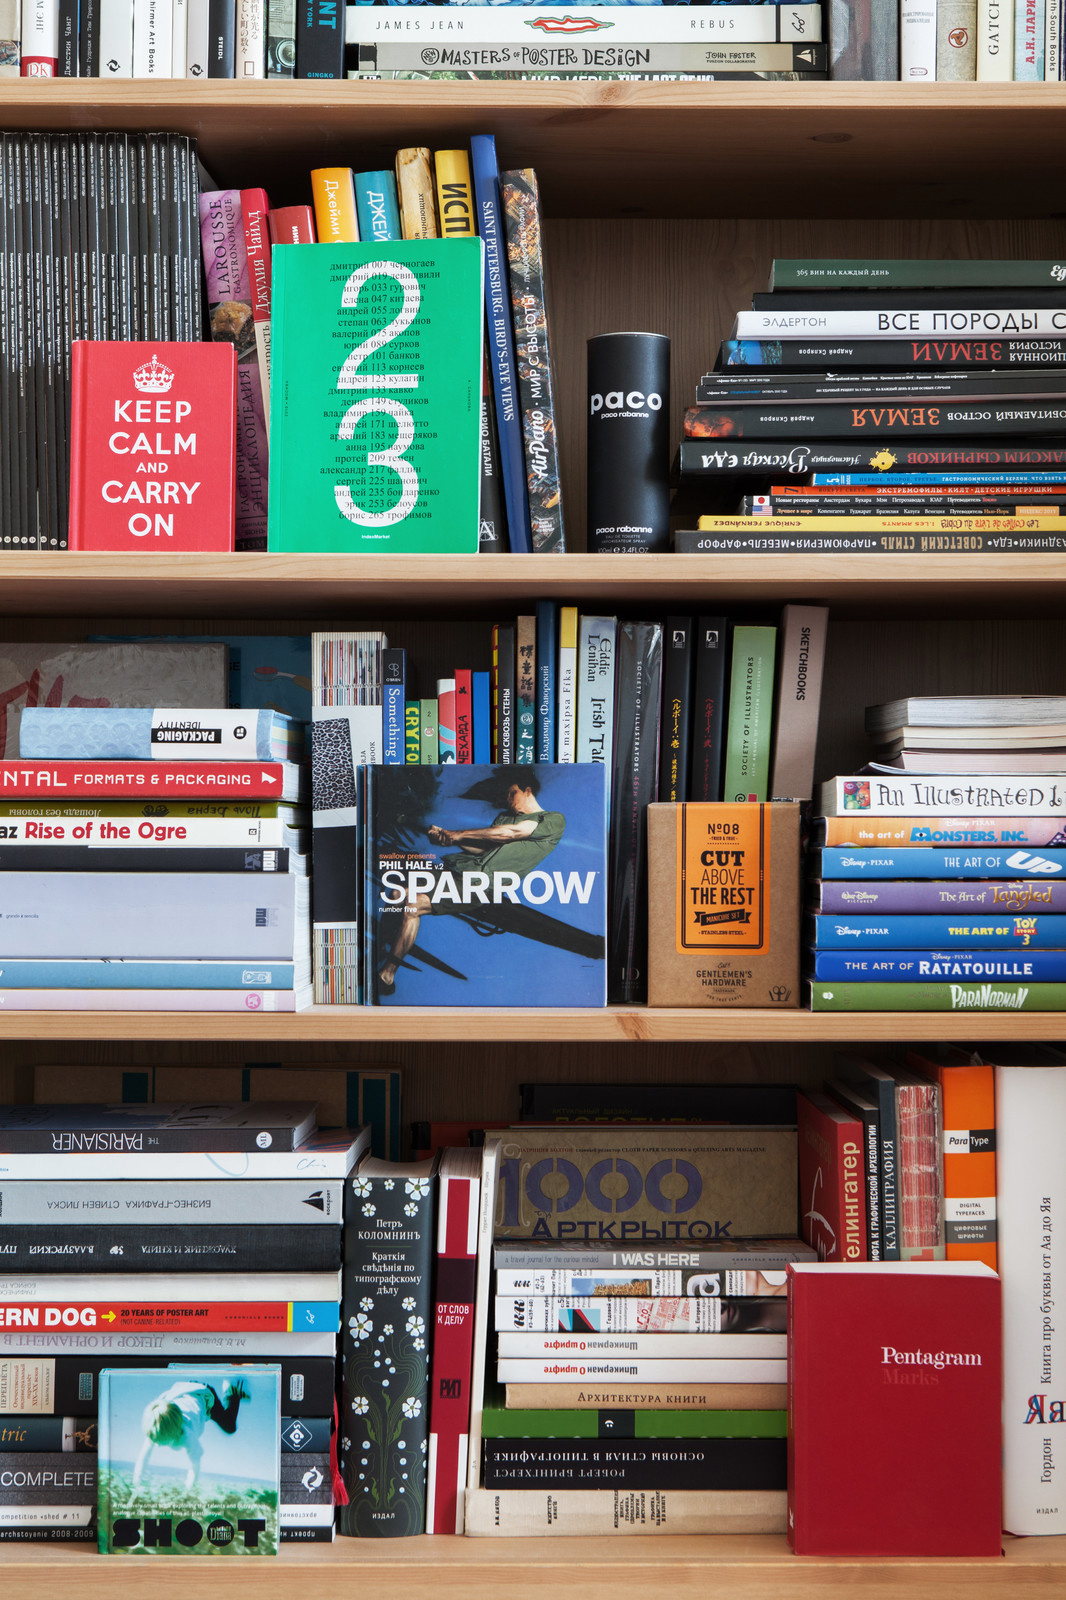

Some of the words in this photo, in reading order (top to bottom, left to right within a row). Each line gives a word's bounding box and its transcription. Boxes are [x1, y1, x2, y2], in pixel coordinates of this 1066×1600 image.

[376, 21, 420, 30] JAMES
[430, 21, 464, 30] JEAN
[690, 20, 735, 29] REBUS
[441, 47, 510, 66] MASTERS
[521, 47, 578, 66] POSTER
[705, 51, 727, 59] JOHN
[323, 180, 341, 235] Джейми
[247, 210, 262, 256] Чайлд
[209, 199, 232, 295] LAROUSSE
[224, 198, 242, 294] GASTRONOMIQUE
[330, 261, 369, 271] дмитрий
[371, 260, 387, 268] 007
[838, 268, 869, 276] КАЖДЫЙ
[255, 259, 272, 314] Джулия
[336, 306, 368, 315] андрей
[371, 306, 387, 314] 055
[483, 201, 496, 235] SAINT
[501, 387, 514, 422] VIEWS
[524, 295, 539, 353] ВЫСОТЫ
[763, 317, 827, 328] ЭЛДЕРТОН
[878, 313, 920, 331] ВСЕ
[933, 312, 1038, 332] ПОРОДЫ
[911, 342, 1002, 361] ЗЕМЛИ
[1009, 341, 1061, 350] ИСТОРИЯ
[528, 369, 542, 398] МИР
[590, 391, 662, 415] paco
[114, 399, 192, 423] KEEP
[600, 412, 618, 420] paco
[851, 408, 940, 427] ЗЕМЛЯ
[947, 411, 992, 420] ОСТРОВ
[108, 431, 196, 455] CALM
[907, 451, 1000, 464] СЫРНИКОВ
[136, 462, 168, 474] AND
[320, 466, 366, 475] александр
[369, 465, 385, 473] 217
[101, 480, 201, 504] CARRY
[128, 512, 174, 536] ON
[595, 527, 615, 535] paco
[616, 525, 653, 534] rabanne
[880, 536, 915, 550] СТИЛЬ
[921, 535, 983, 552] СОВЕТСКИЙ
[587, 634, 600, 682] Lenihan
[599, 637, 612, 676] Eddie
[796, 626, 811, 701] SKETCHBOOKS
[562, 669, 572, 694] Fika
[744, 656, 754, 722] ILLUSTRATORS
[502, 688, 511, 716] СТЕНЫ
[590, 696, 606, 728] Irish
[158, 721, 202, 730] IDENTITY
[385, 688, 400, 757] Something
[405, 707, 420, 740] CRY
[562, 698, 573, 746] maxipsa
[156, 731, 216, 742] PACKAGING
[502, 717, 511, 748] СКВОЗЬ
[744, 724, 750, 736] OF
[539, 717, 551, 761] Владимир
[633, 713, 641, 772] ILLUSTRATORS
[73, 773, 146, 786] FORMATS
[150, 773, 160, 786] &
[165, 773, 252, 786] PACKAGING
[25, 821, 65, 840] Rise
[72, 821, 94, 840] of
[100, 821, 131, 840] the
[138, 821, 188, 842] Ogre
[1001, 831, 1028, 842] INC.
[407, 853, 436, 861] presents
[700, 850, 746, 866] CUT
[870, 858, 894, 866] PIXAR
[944, 857, 961, 868] THE
[964, 857, 982, 868] ART
[985, 857, 1000, 868] OF
[379, 861, 404, 870] PHIL
[405, 861, 432, 870] HALE
[701, 868, 744, 886] ABOVE
[380, 870, 596, 905] SPARROW
[690, 887, 718, 905] THE
[721, 887, 756, 906] REST
[989, 885, 1053, 911] Tangled
[1013, 917, 1038, 928] TOY
[845, 962, 868, 970] THE
[873, 962, 896, 970] ART
[899, 962, 914, 970] OF
[919, 961, 1033, 975] RATATOUILLE
[696, 970, 752, 979] GENTLEMEN'S
[702, 978, 746, 987] HARDWARE
[51, 1132, 144, 1150] PARISIANER
[868, 1124, 878, 1174] АРХЕОЛОГИИ
[883, 1140, 897, 1250] КАЛЛИГРАФИЯ
[47, 1201, 80, 1209] ЛИСКА
[82, 1200, 120, 1209] СТИВЕН
[126, 1200, 212, 1209] БИЗНЕС-ГРАФИКА
[376, 1219, 403, 1230] Петръ
[358, 1231, 421, 1240] КОЛОМНИНЪ
[957, 1232, 984, 1240] ШРИФТЫ
[621, 1253, 654, 1266] WAS
[657, 1253, 700, 1266] HERE
[1042, 1253, 1052, 1269] от
[354, 1274, 422, 1286] типографскому
[1040, 1272, 1055, 1314] буквы
[120, 1309, 131, 1317] 20
[131, 1309, 154, 1317] YEARS
[155, 1309, 166, 1317] OF
[166, 1309, 193, 1317] POSTER
[194, 1309, 209, 1317] ART
[437, 1304, 448, 1314] ОТ
[449, 1304, 470, 1315] СЛОВ
[44, 1308, 97, 1326] DOG
[444, 1315, 465, 1326] ДЕЛУ
[1042, 1316, 1055, 1342] про
[17, 1335, 98, 1348] ОРНАМЕНТ
[102, 1335, 113, 1348] И
[117, 1334, 165, 1350] ДЕКОР
[543, 1340, 578, 1351] шрифте
[579, 1341, 586, 1351] О
[587, 1341, 638, 1351] Шпикерман
[881, 1346, 982, 1370] Pentagram
[1040, 1344, 1052, 1384] Книга
[543, 1364, 578, 1376] шрифте
[579, 1365, 586, 1376] О
[587, 1365, 638, 1376] Шпикерман
[883, 1368, 940, 1386] Marks
[493, 1451, 589, 1462] ТИПОГРАФИКЕ
[605, 1452, 646, 1462] СТИЛЯ
[651, 1452, 705, 1462] ОСНОВЫ
[1040, 1437, 1056, 1484] Гордон
[0, 1471, 94, 1487] COMPLETE
[493, 1468, 574, 1478] БРИНГХЕРСТ
[578, 1468, 626, 1478] РОБЕРТ
[51, 1530, 94, 1538] 2008-2009
[112, 1518, 266, 1548] SHOOT
